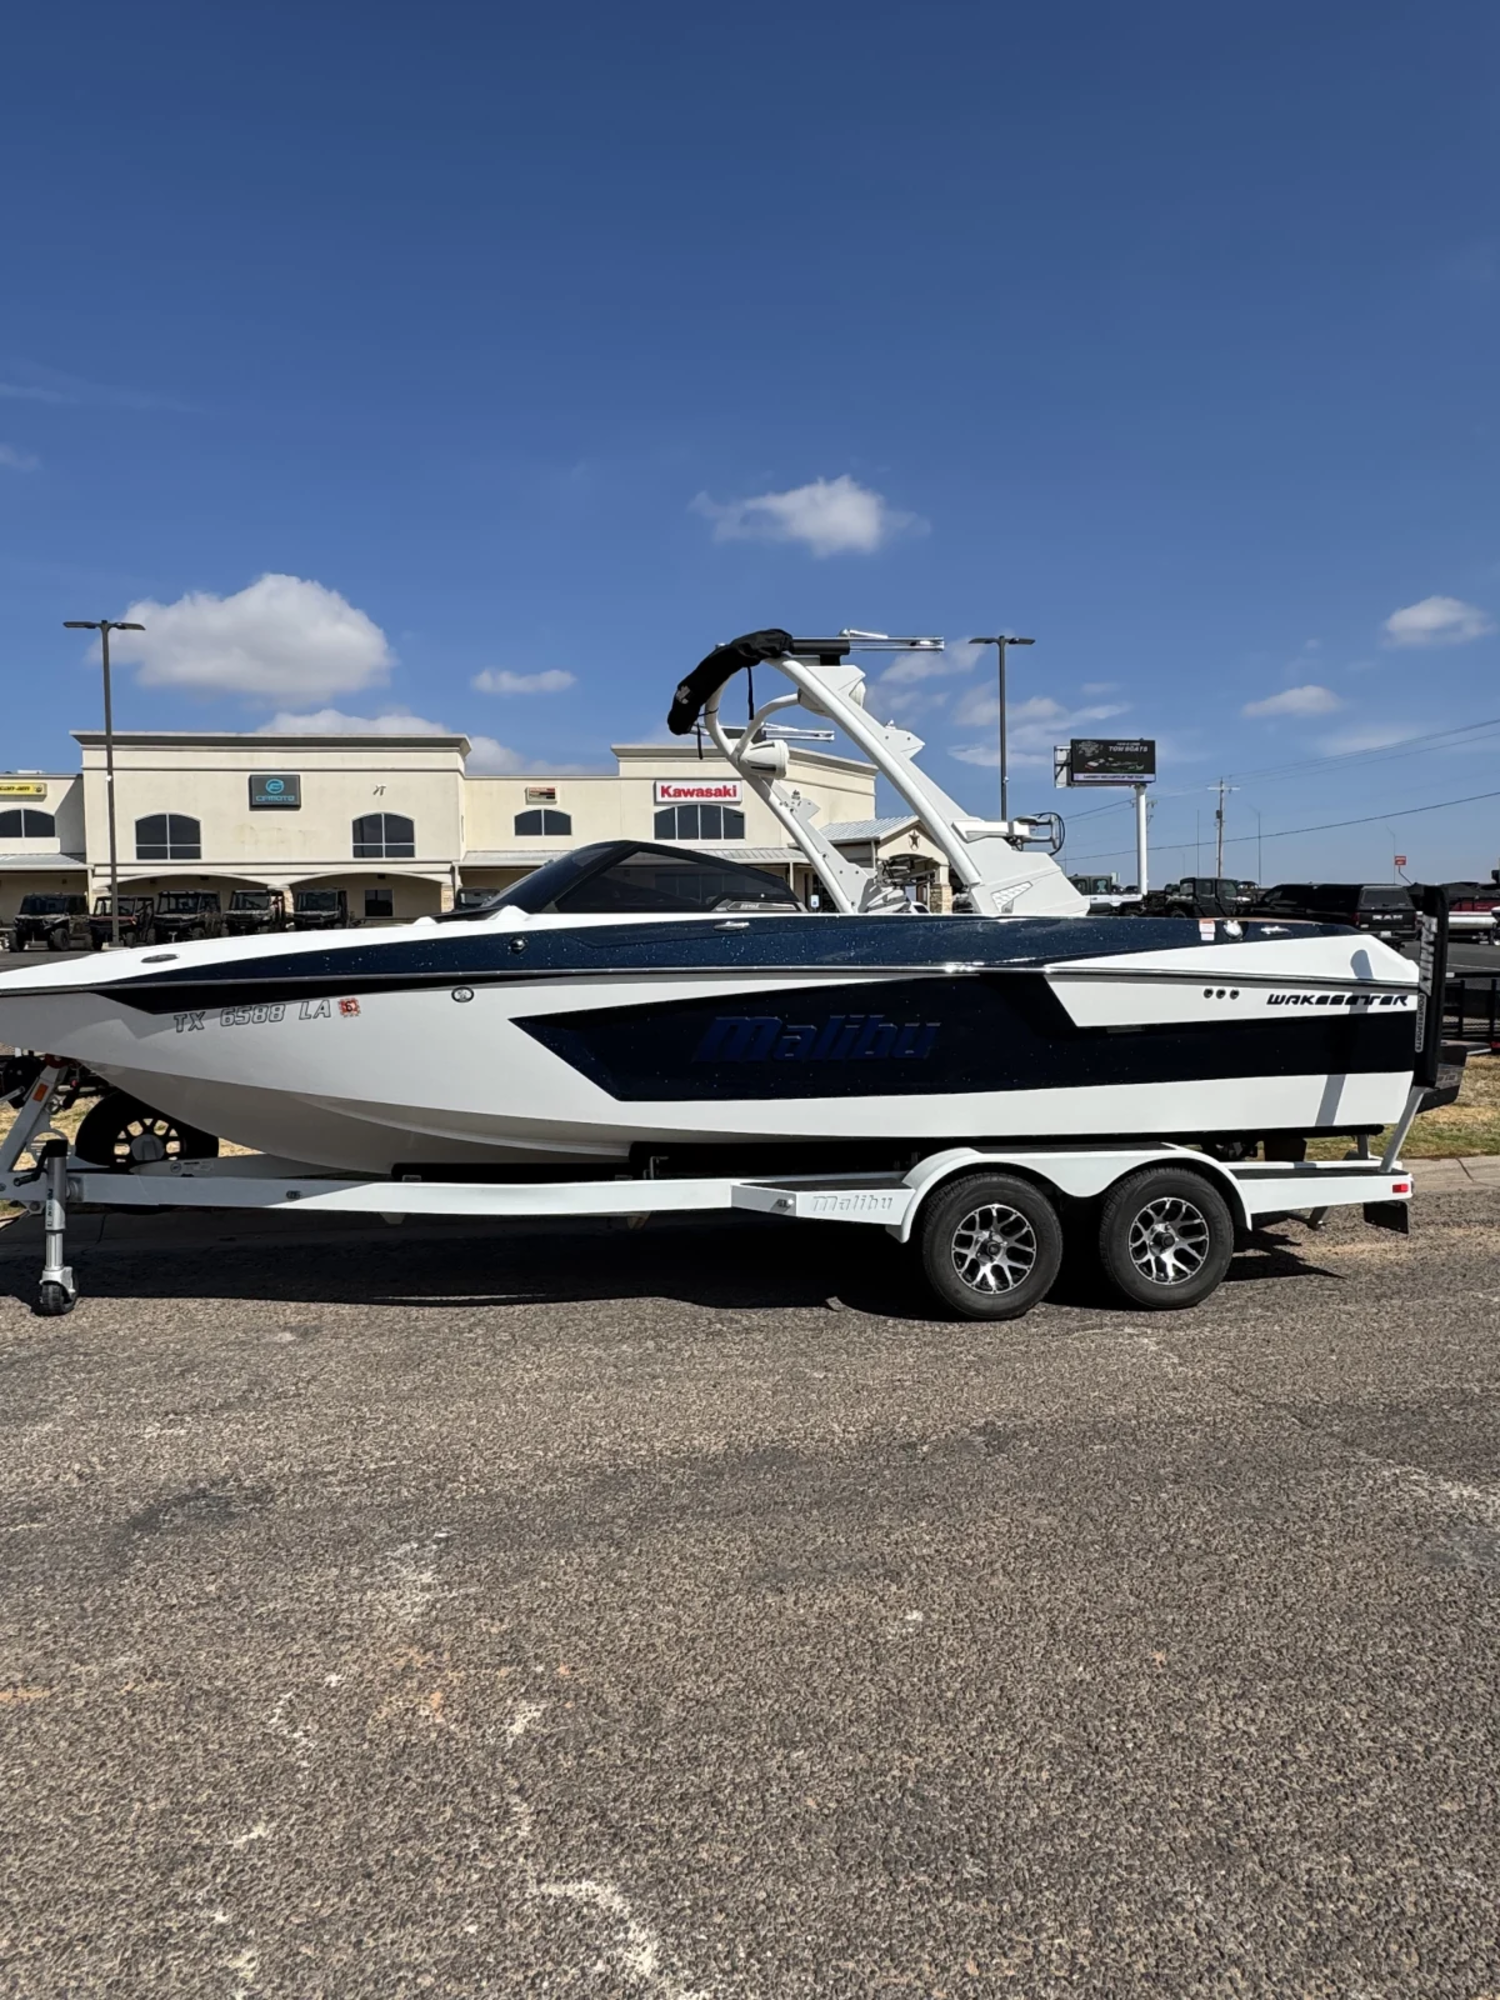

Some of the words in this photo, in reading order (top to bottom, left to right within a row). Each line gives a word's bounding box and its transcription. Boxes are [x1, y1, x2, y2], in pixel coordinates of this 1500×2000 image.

[660, 785, 737, 798] Kawasaki
[174, 1011, 206, 1033] TX
[220, 1003, 285, 1027] 6588
[298, 999, 331, 1020] LA
[691, 1015, 942, 1062] Malibu
[812, 1194, 893, 1212] Malibu
